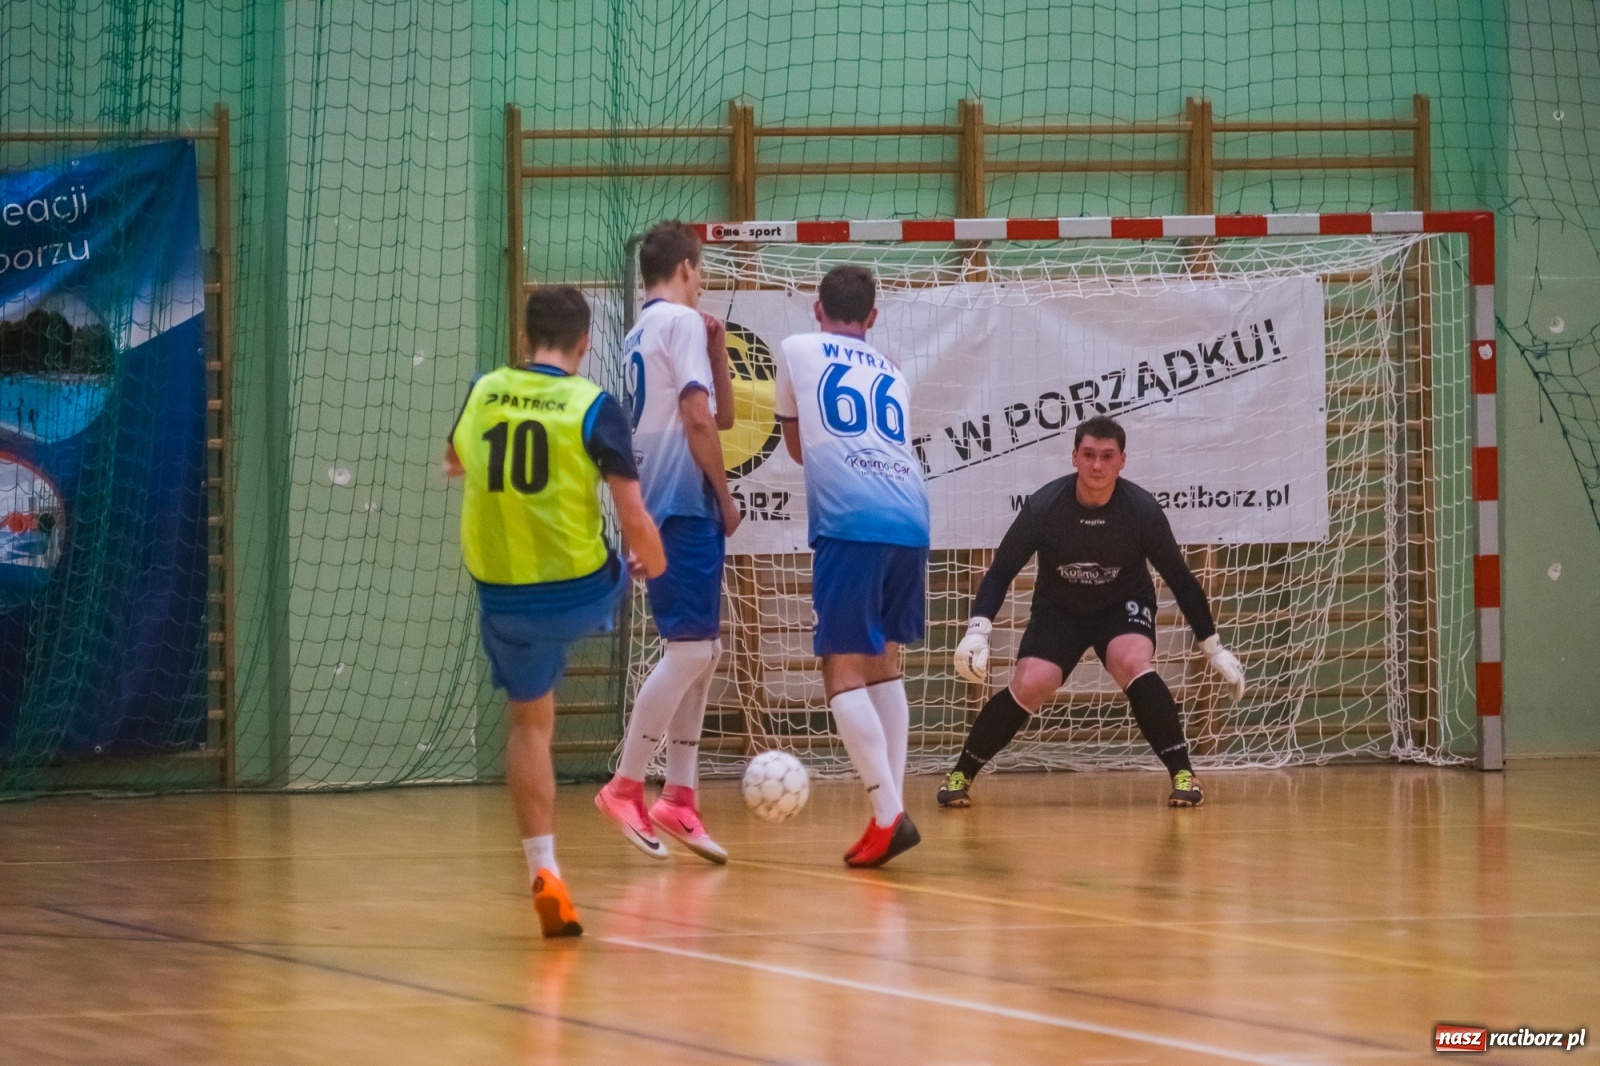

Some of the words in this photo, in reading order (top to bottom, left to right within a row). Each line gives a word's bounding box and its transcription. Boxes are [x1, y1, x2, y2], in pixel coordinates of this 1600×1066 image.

[2, 185, 88, 226] eacji
[749, 222, 782, 239] sport
[817, 362, 906, 446] 66
[944, 414, 992, 462] W
[1003, 318, 1282, 444] PORZĄDKU!
[482, 419, 549, 496] 10
